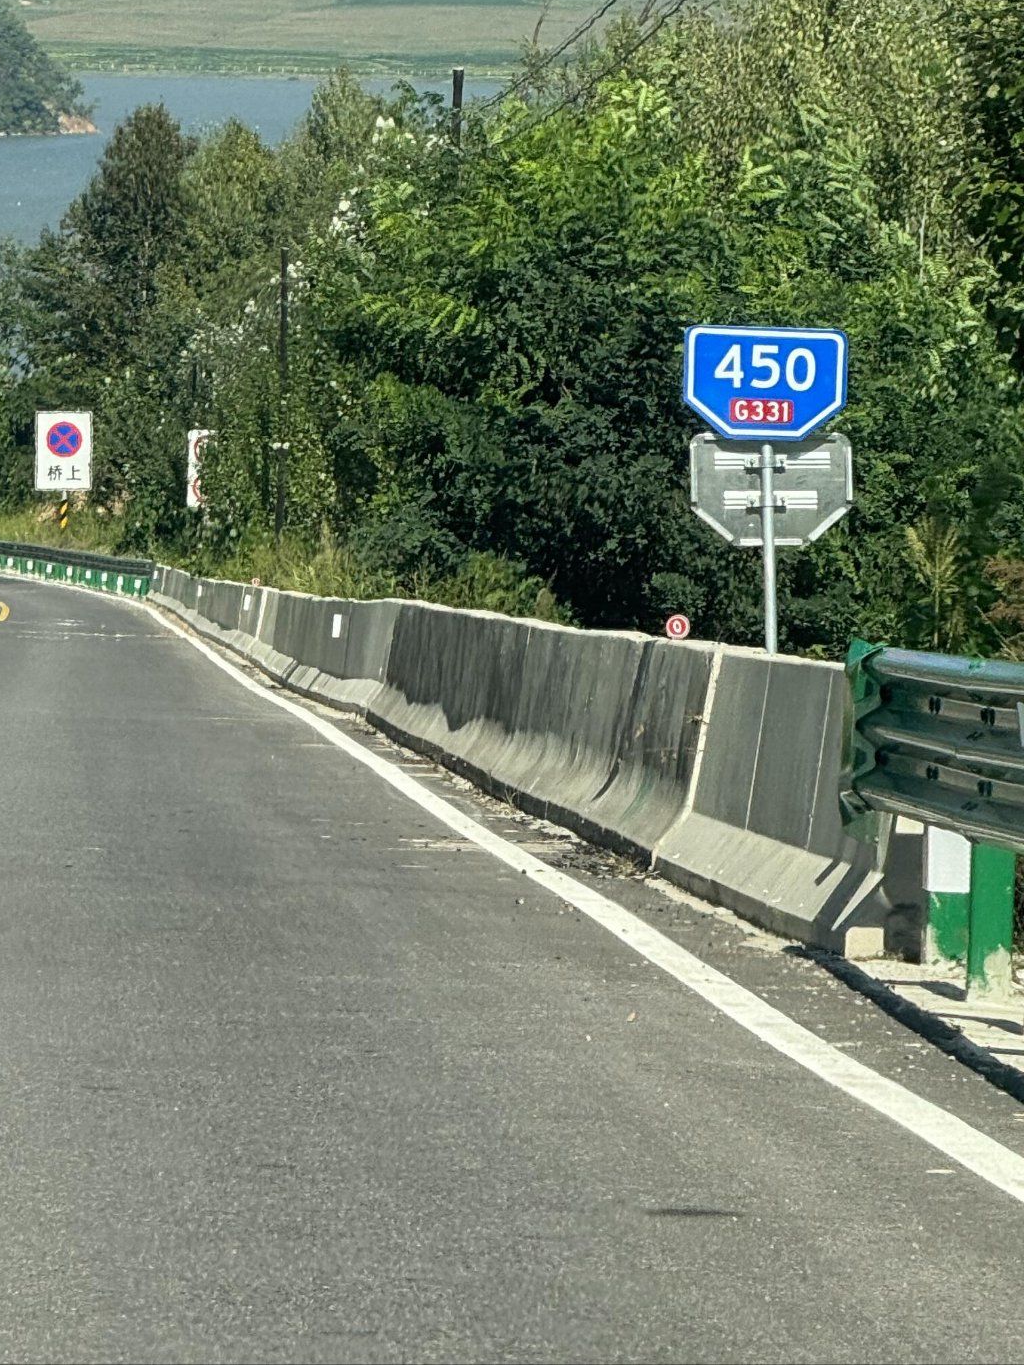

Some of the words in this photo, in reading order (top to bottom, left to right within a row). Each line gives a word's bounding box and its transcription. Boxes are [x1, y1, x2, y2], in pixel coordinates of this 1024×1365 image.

[714, 344, 816, 391] 450
[734, 400, 790, 422] G331
[47, 465, 82, 481] 桥上
